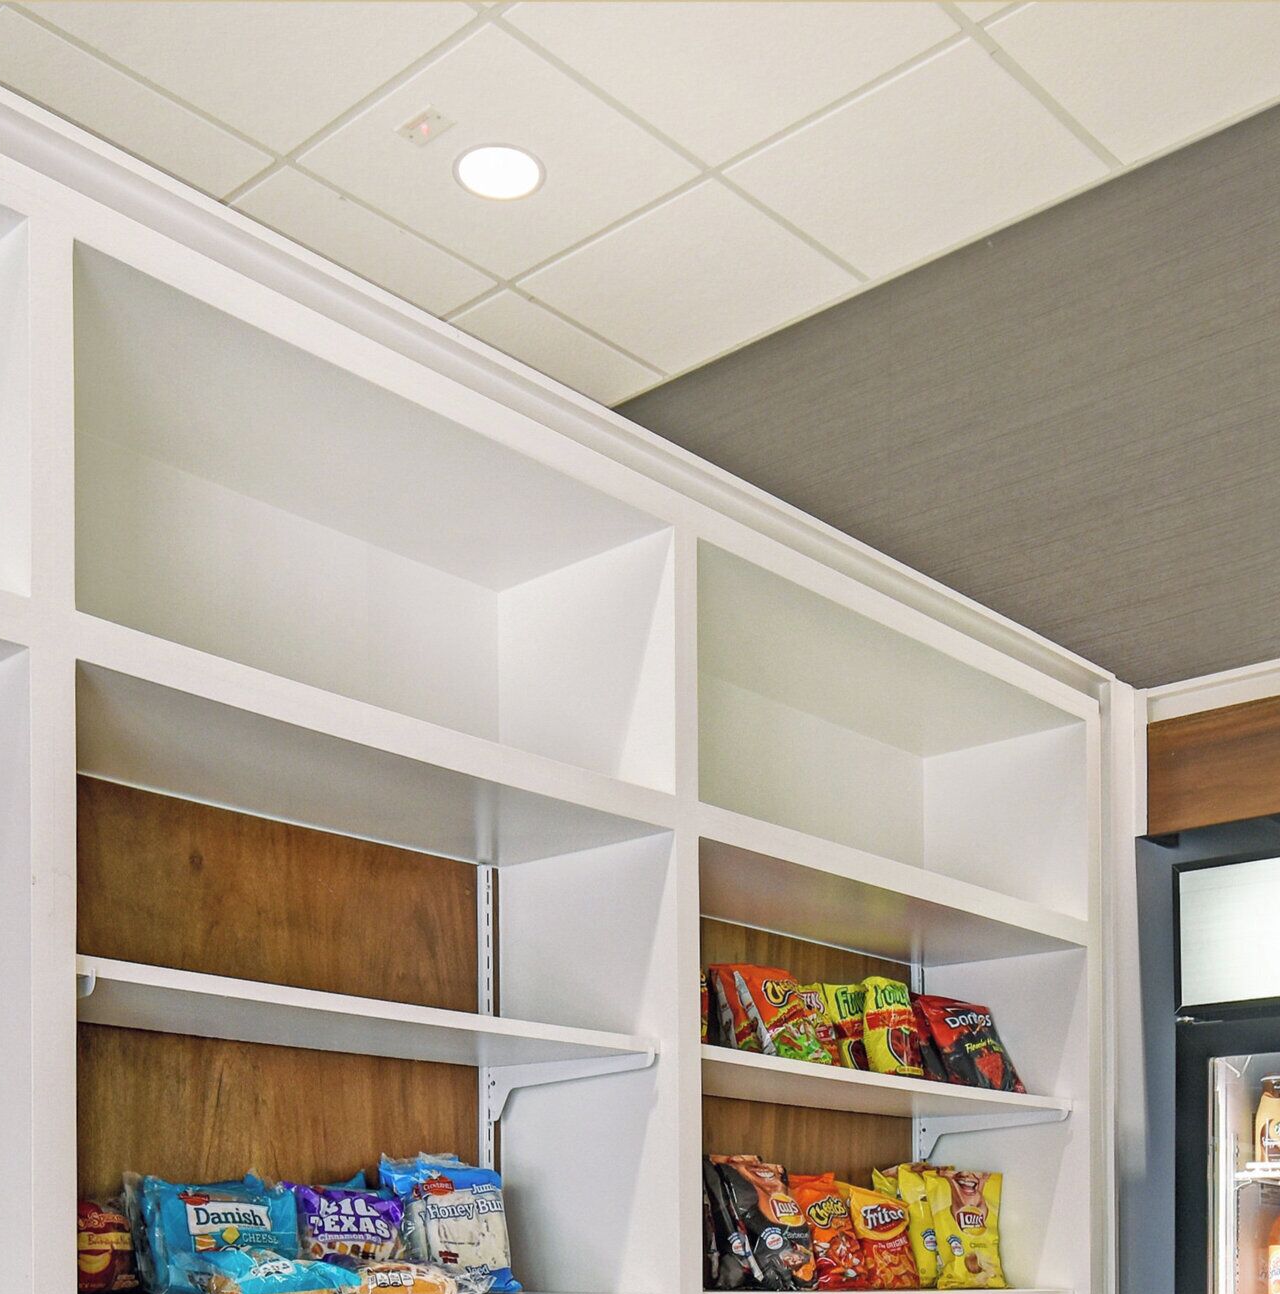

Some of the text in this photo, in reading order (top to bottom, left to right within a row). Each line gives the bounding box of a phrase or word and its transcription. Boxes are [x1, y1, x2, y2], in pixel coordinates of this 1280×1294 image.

[944, 1012, 992, 1029] Doritos
[195, 1206, 266, 1227] Danish
[427, 1199, 504, 1220] Honey Bun
[860, 1204, 906, 1230] Fritos
[309, 1214, 391, 1239] TEXAS
[242, 1233, 279, 1244] CHEESE
